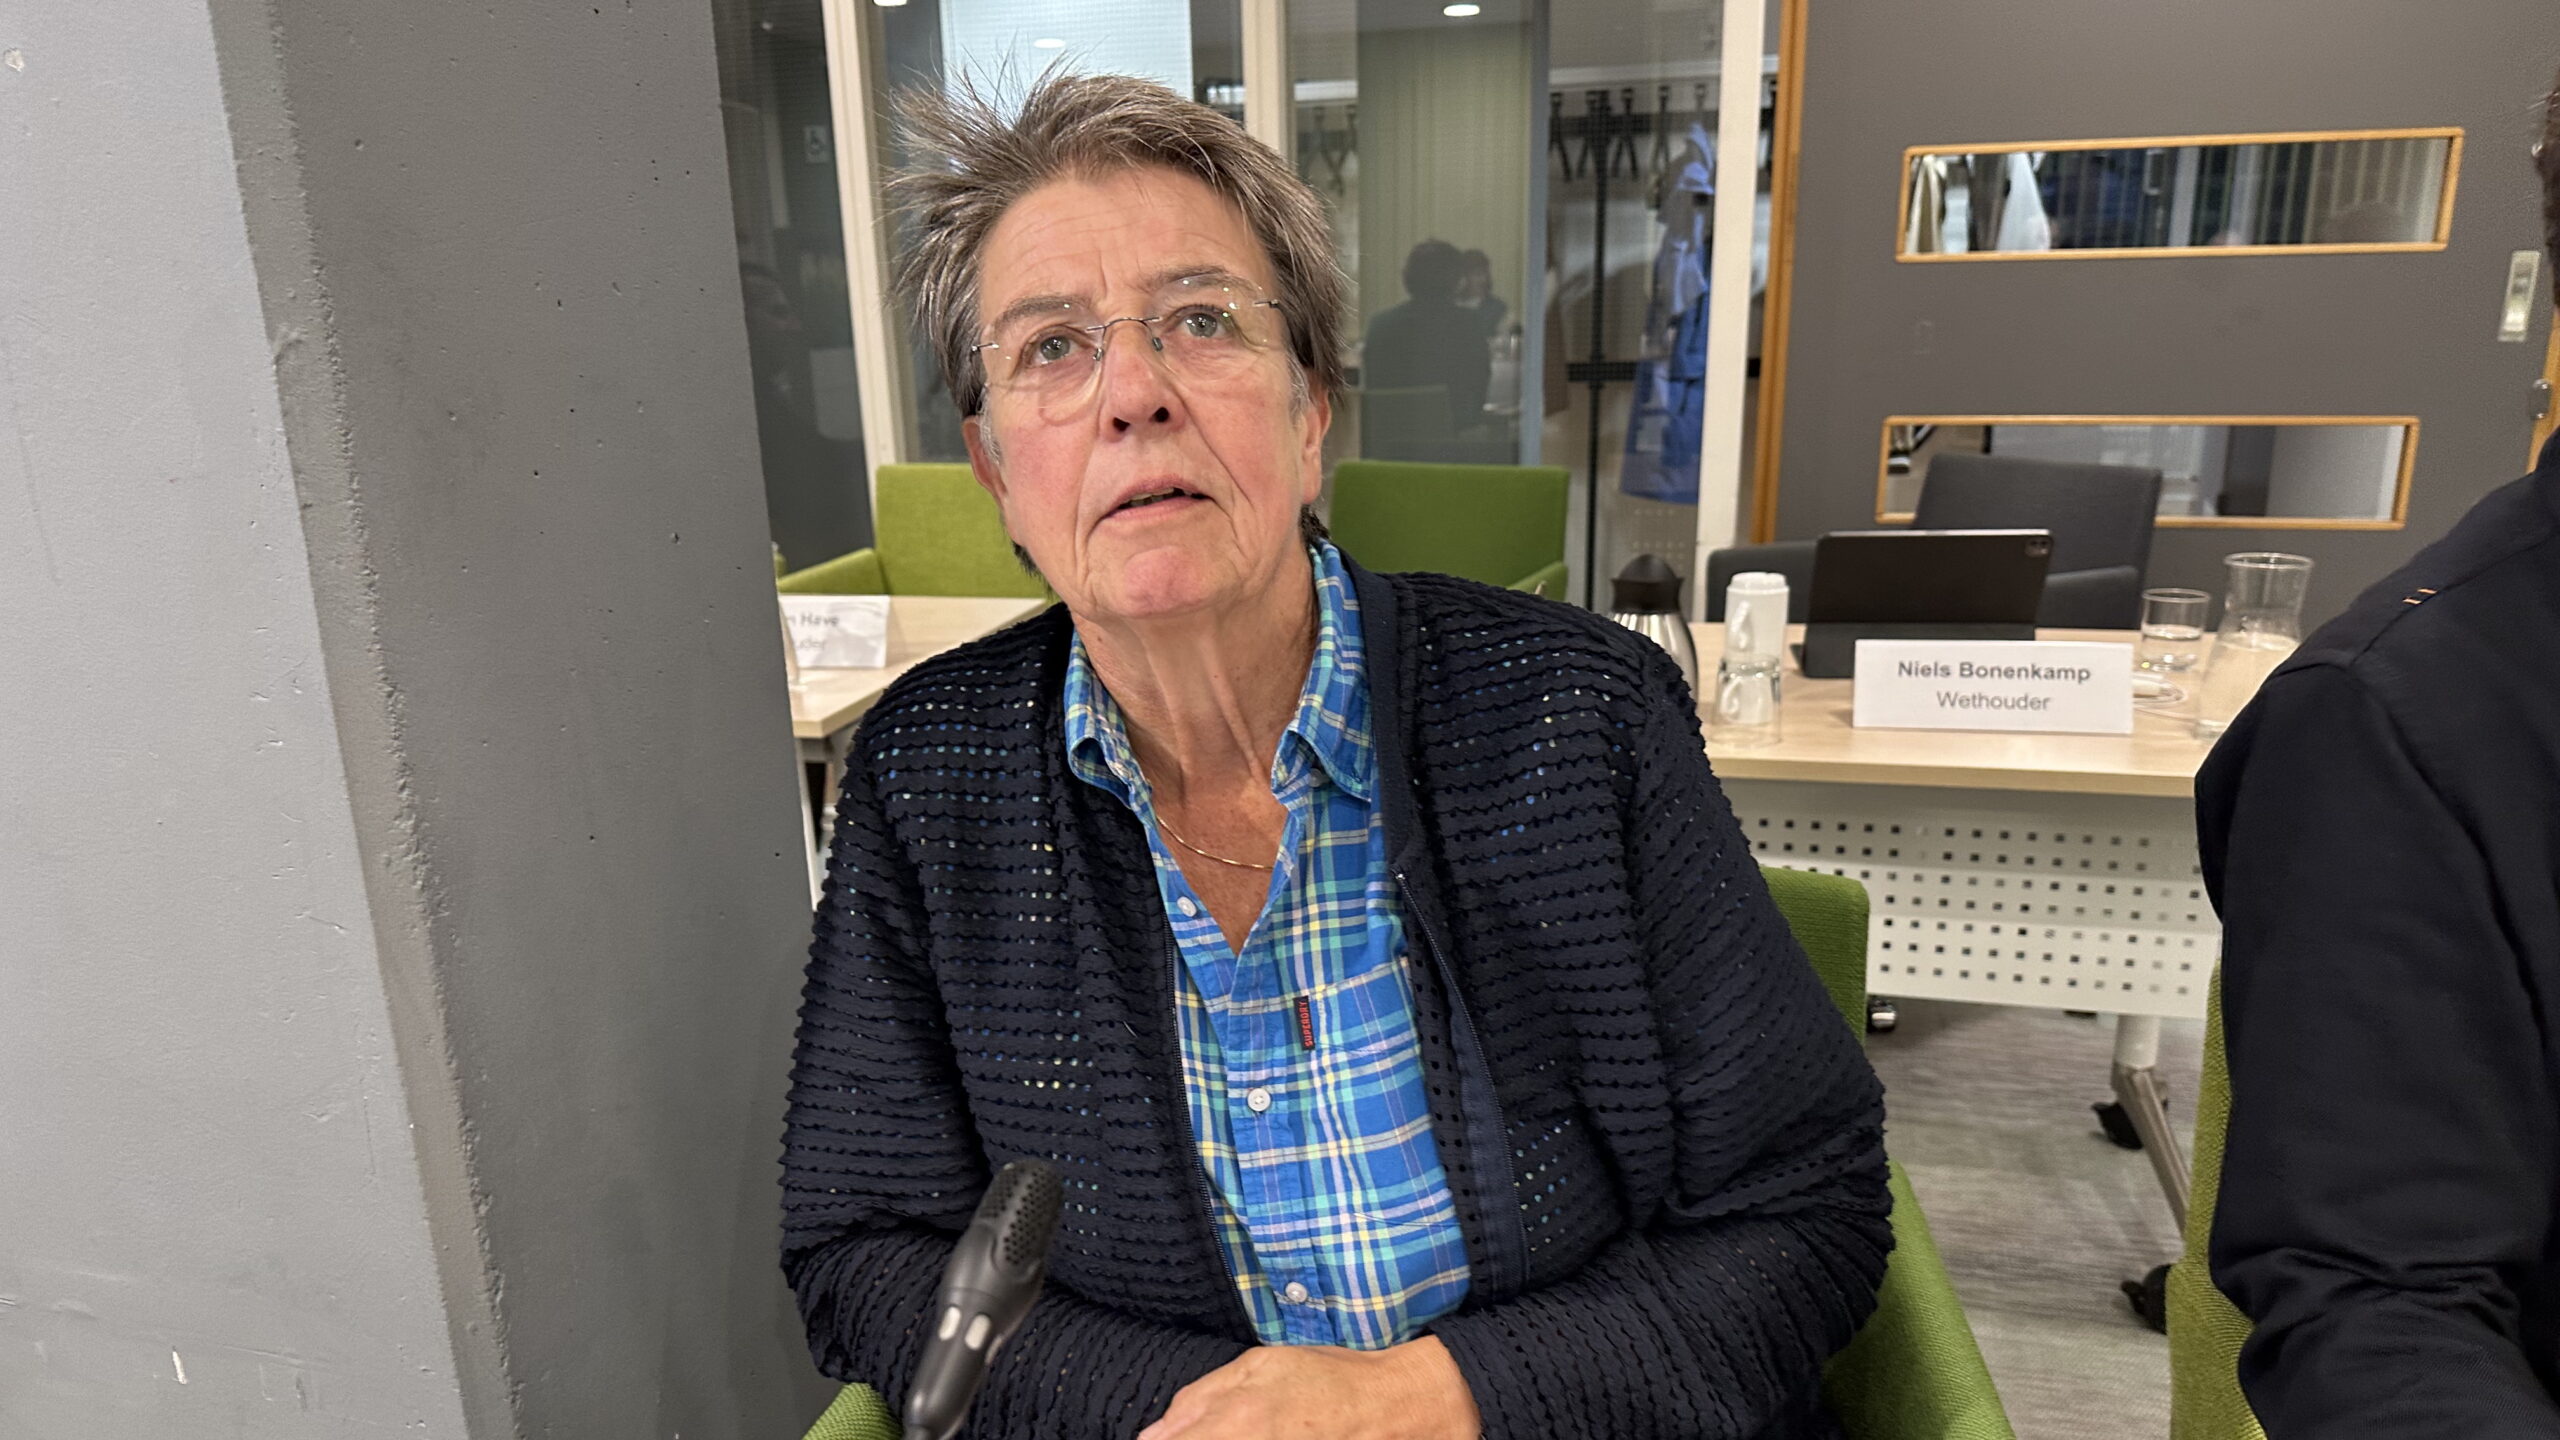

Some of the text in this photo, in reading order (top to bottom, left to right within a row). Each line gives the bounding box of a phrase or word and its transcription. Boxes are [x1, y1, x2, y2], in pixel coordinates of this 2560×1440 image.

[800, 612, 839, 627] Have
[1898, 660, 2091, 684] Niels Bonenkamp
[1937, 691, 2050, 711] Wethouder
[1299, 1001, 1314, 1048] SUPERDRY
